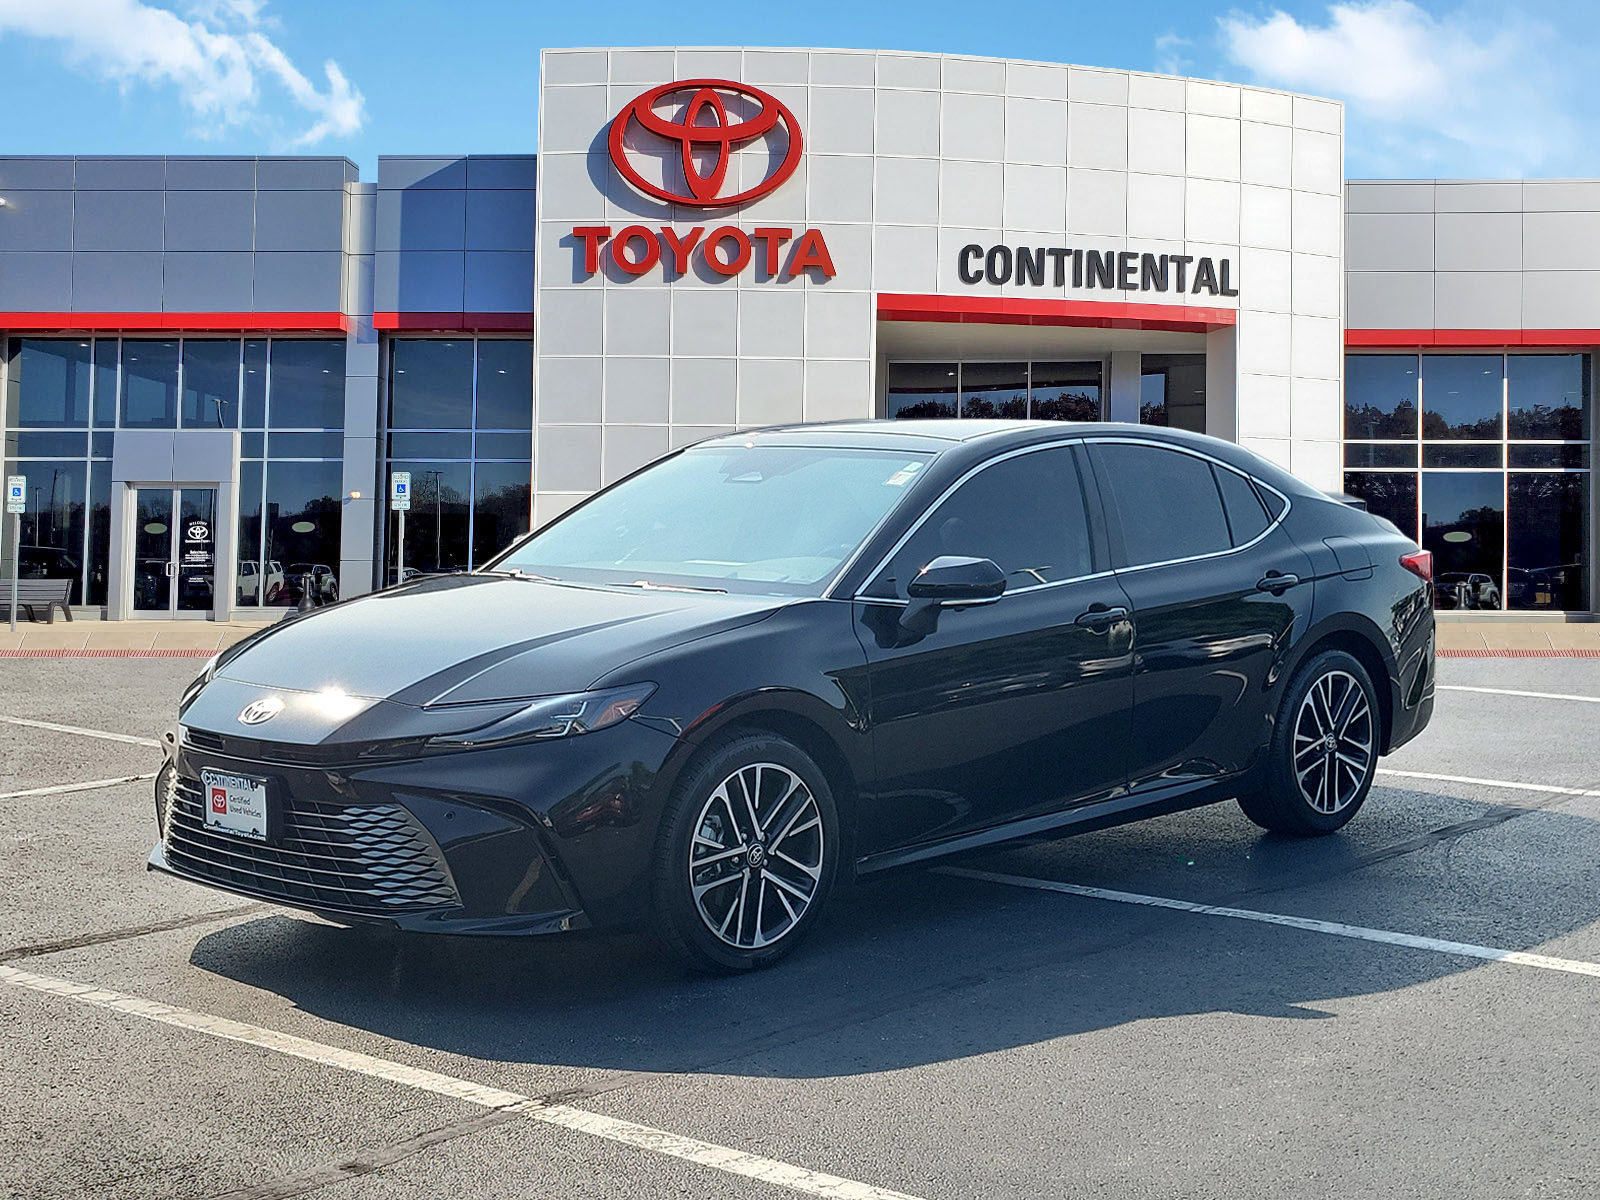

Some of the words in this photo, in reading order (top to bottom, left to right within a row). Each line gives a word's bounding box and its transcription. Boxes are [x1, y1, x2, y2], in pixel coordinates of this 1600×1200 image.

[573, 225, 836, 276] TOYOTA
[959, 244, 1238, 296] CONTINENTAL
[203, 772, 253, 791] CONTINENTAL
[229, 795, 251, 805] Certified
[230, 806, 242, 814] Used
[243, 807, 262, 818] Vehicles
